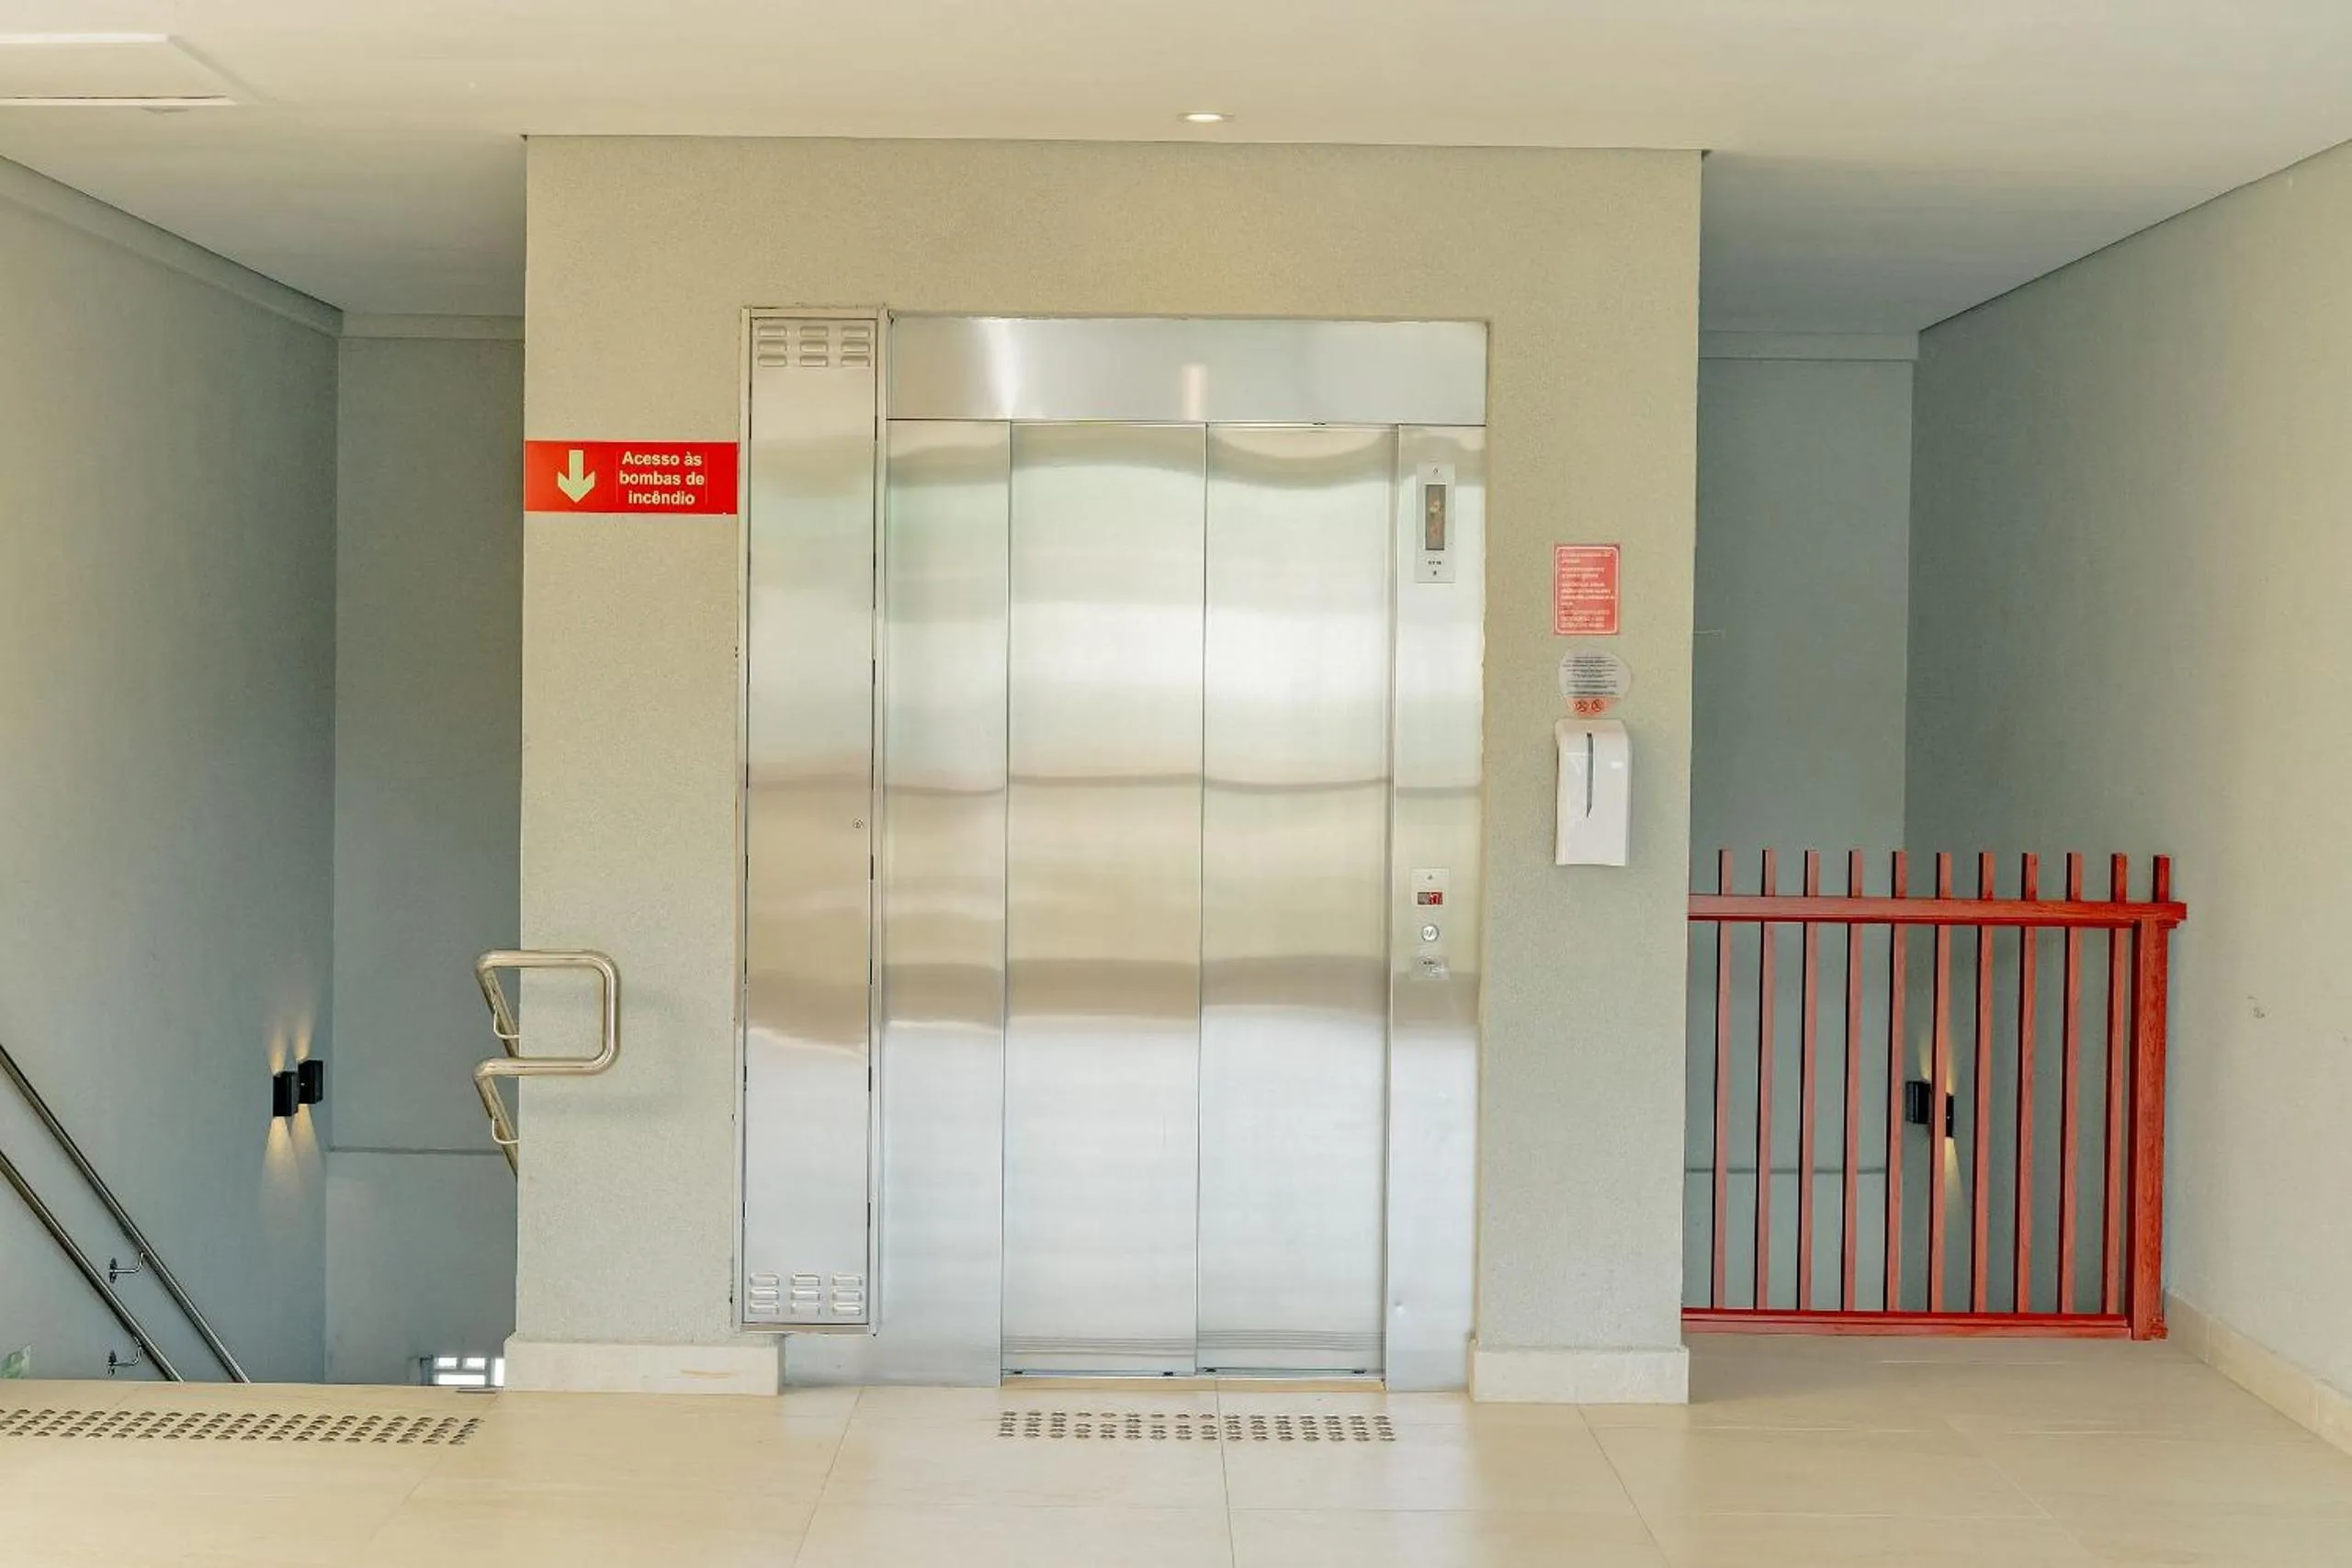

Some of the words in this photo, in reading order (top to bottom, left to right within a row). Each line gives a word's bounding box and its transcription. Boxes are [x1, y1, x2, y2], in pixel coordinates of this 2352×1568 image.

[622, 451, 679, 466] Acesso
[684, 451, 702, 467] às
[619, 470, 681, 485] bombas
[685, 471, 705, 485] de
[628, 490, 695, 504] incêndio
